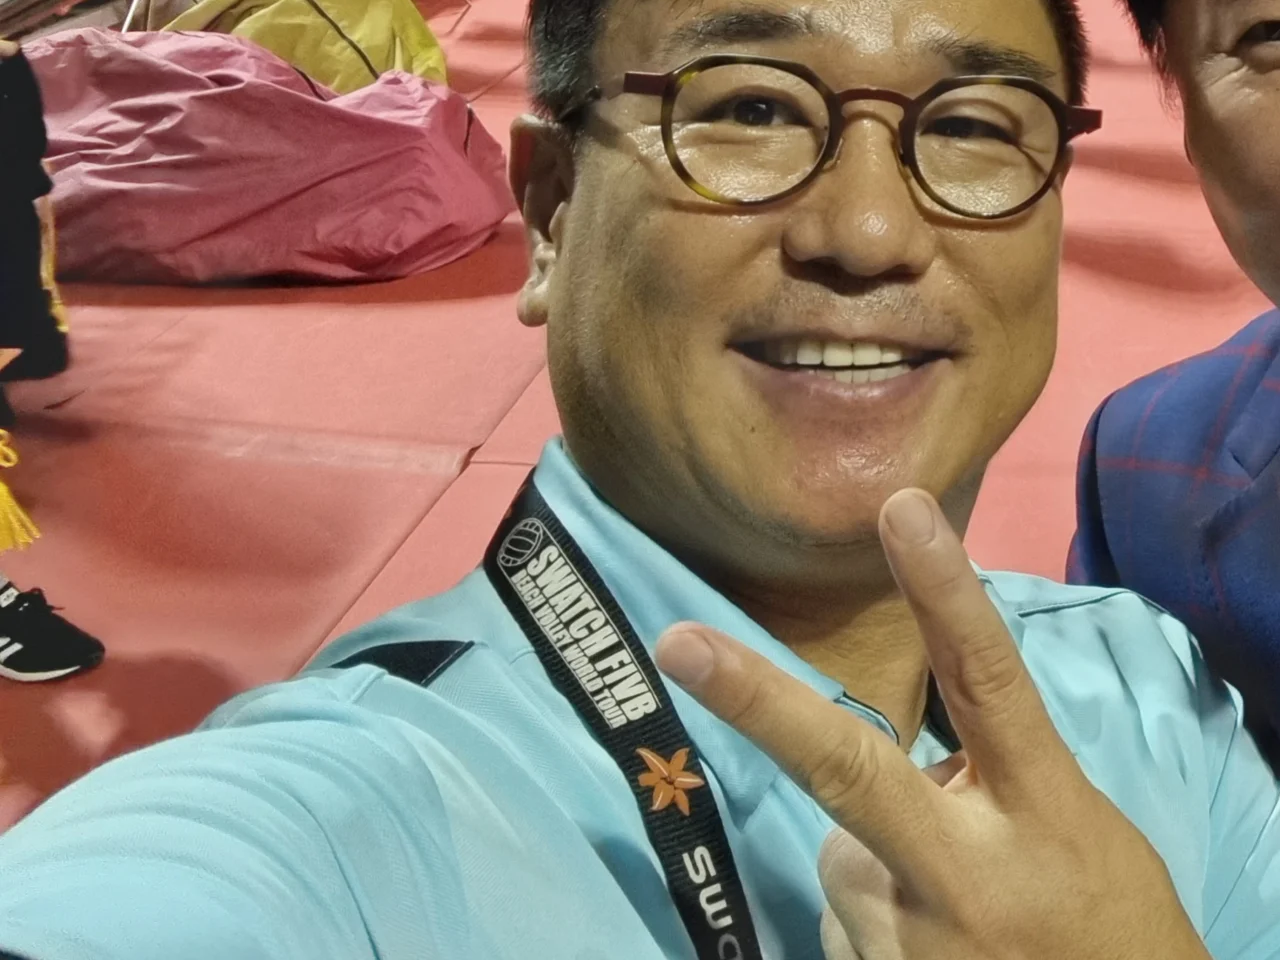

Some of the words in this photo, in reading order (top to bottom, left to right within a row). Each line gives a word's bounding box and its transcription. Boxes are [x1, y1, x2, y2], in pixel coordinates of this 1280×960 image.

[510, 570, 544, 610] BEACH
[535, 603, 573, 649] VOLLEY
[562, 643, 602, 691] WORLD
[594, 690, 628, 730] TOUR
[526, 545, 614, 652] SWATCH
[598, 648, 657, 724] FIVB
